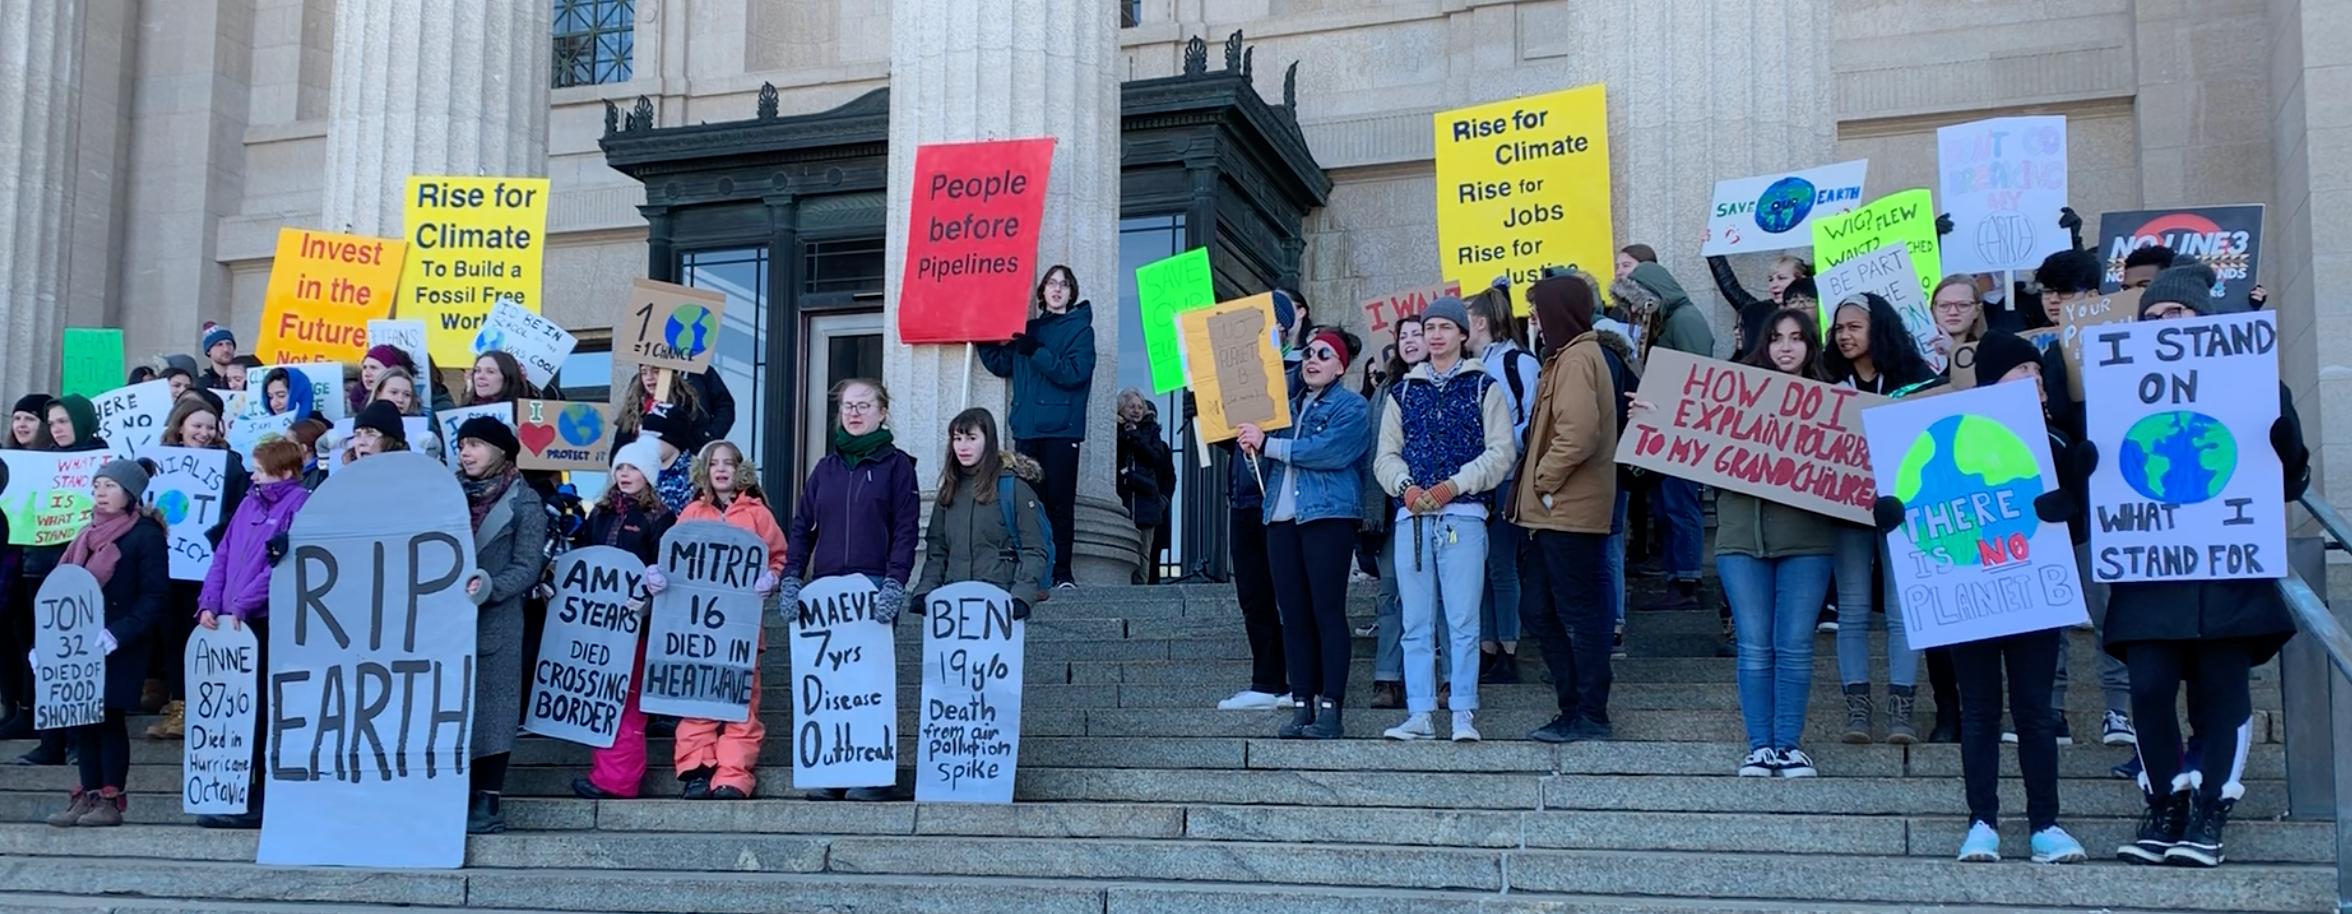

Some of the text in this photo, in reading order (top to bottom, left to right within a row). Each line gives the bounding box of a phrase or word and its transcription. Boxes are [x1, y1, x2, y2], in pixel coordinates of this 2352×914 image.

[1453, 109, 1548, 142] Rise for
[1496, 135, 1588, 165] Climate
[417, 183, 537, 208] Rise for
[930, 170, 1027, 202] People
[1459, 179, 1544, 204] Rise for
[1717, 202, 1755, 217] SAVE
[1817, 186, 1860, 205] EARTH
[929, 213, 1018, 242] before
[1503, 204, 1564, 228] Jobs
[1876, 203, 1917, 231] FLEW
[300, 233, 383, 265] Invest
[416, 223, 531, 249] Climate
[1458, 239, 1543, 265] Rise for
[1977, 215, 2034, 268] EARTH
[422, 260, 521, 278] To Build a
[918, 253, 1018, 283] Pipelines
[1145, 256, 1202, 302] SAVE
[1830, 250, 1903, 296] BE PART
[297, 274, 371, 306] in the
[416, 287, 525, 304] Fossil Free
[441, 313, 486, 330] Worl
[1366, 302, 1388, 331] I
[2066, 299, 2111, 320] YOUR
[653, 342, 695, 362] CHANCE
[2099, 331, 2134, 367] I
[2155, 319, 2276, 362] STAND
[1684, 363, 1858, 432] HOW DO I
[2139, 369, 2198, 404] ON
[122, 414, 152, 429] NO
[1674, 399, 1793, 452] EXPLAIN
[546, 449, 590, 461] PROTECT
[1635, 424, 1665, 456] TO
[1667, 435, 1709, 466] MY
[51, 496, 73, 508] IS
[1904, 489, 2021, 544] THERE
[2097, 498, 2255, 533] WHAT I
[36, 512, 73, 527] WHAT
[669, 541, 763, 588] MITRA
[1909, 532, 2030, 579] IS NO
[2097, 544, 2264, 580] STAND FOR
[295, 532, 464, 653] RIP
[1905, 563, 2074, 633] PLANET B
[42, 589, 94, 631] JON
[691, 595, 725, 629] 16
[932, 598, 1012, 640] BEN
[56, 635, 88, 659] 32
[195, 638, 252, 676] ANNE
[570, 640, 610, 666] DIED
[666, 632, 750, 664] DIED IN
[42, 661, 101, 682] DIED OF
[536, 660, 628, 706] CROSSING
[647, 664, 754, 704] HEATWAVE
[51, 681, 95, 702] FOOD
[803, 675, 882, 716] Disease
[929, 693, 995, 721] Death
[271, 655, 472, 783] EARTH
[535, 691, 616, 736] BORDER
[191, 725, 242, 750] Died in
[801, 721, 894, 768] Outbreak
[923, 723, 999, 741] from air
[190, 755, 250, 775] Hurricane
[929, 741, 1011, 762] pollution
